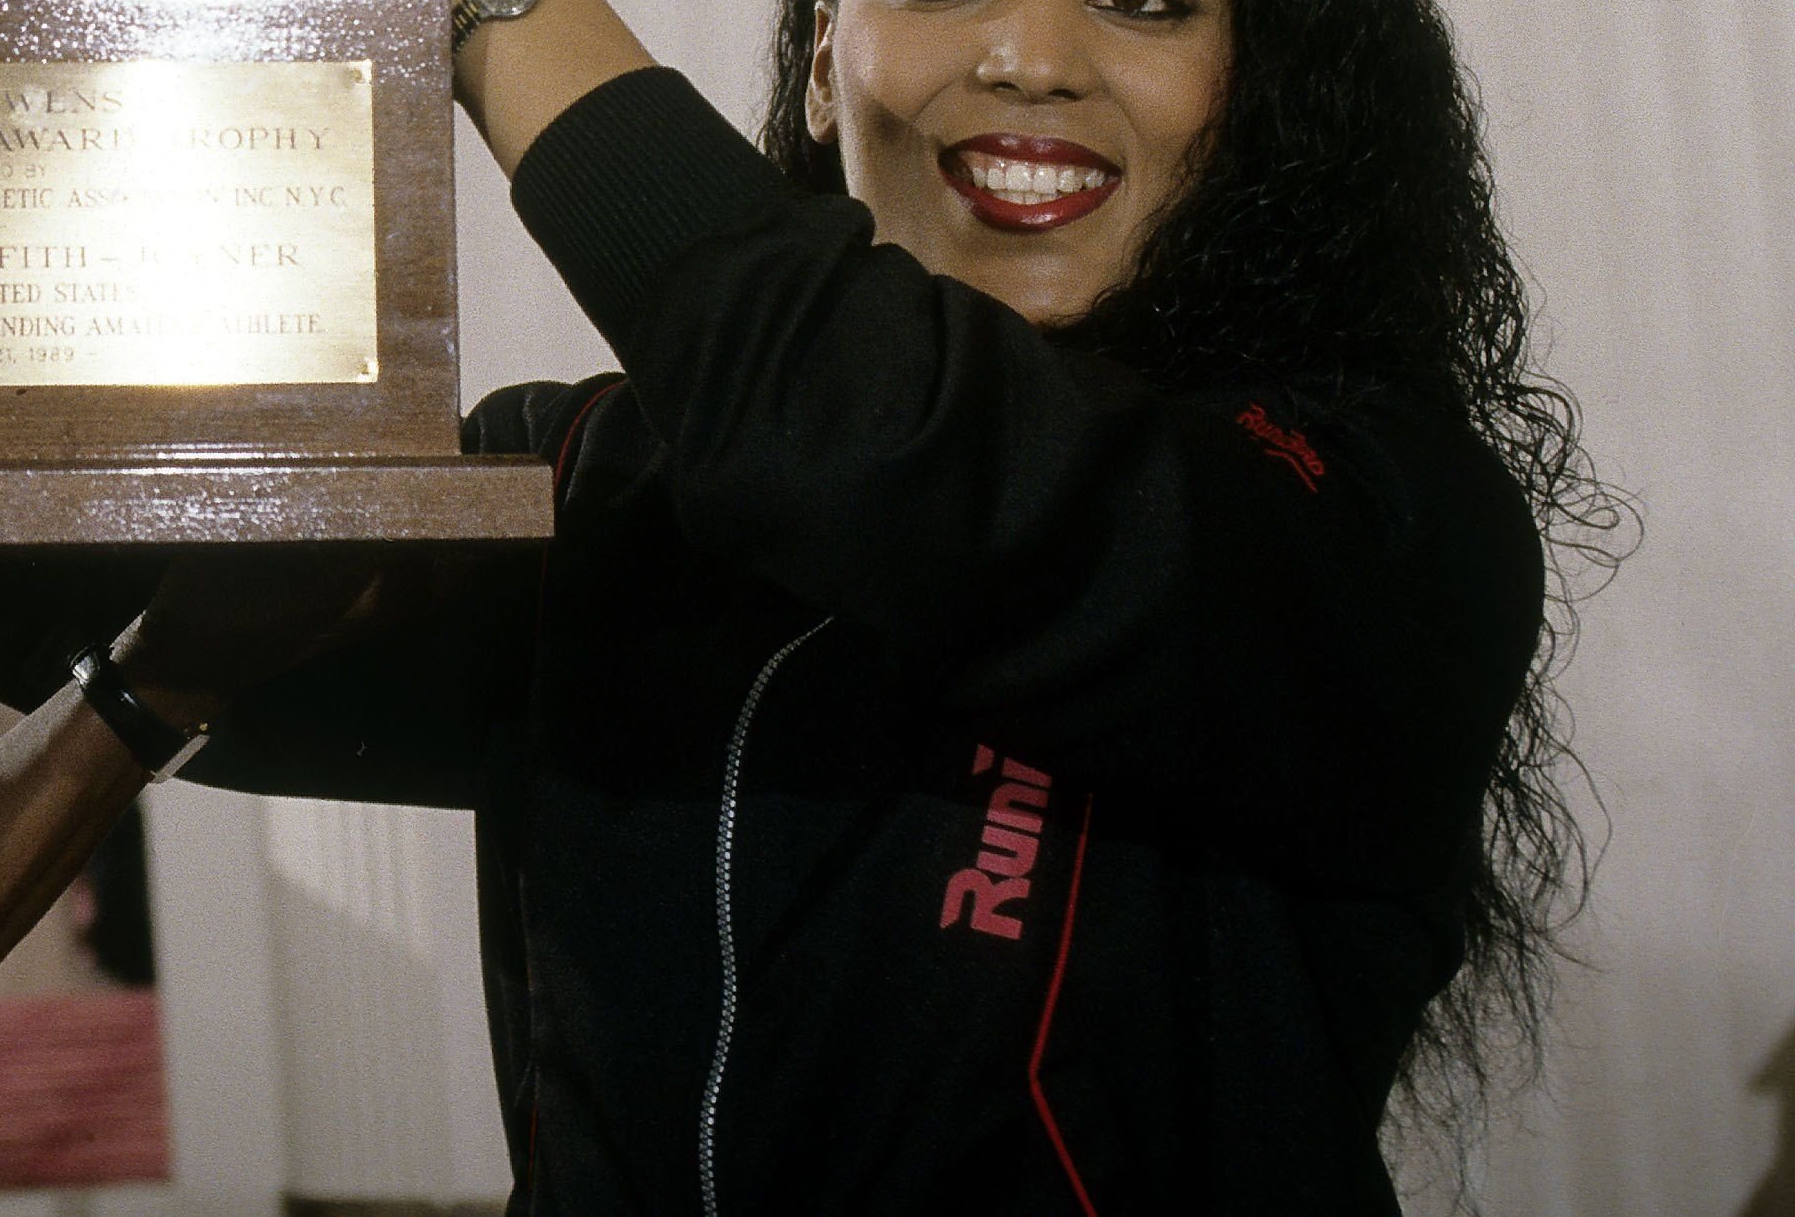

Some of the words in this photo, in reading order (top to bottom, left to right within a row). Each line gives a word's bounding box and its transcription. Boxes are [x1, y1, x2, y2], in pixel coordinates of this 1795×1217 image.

[170, 126, 331, 151] ROPHY
[130, 245, 304, 270] JNER
[25, 346, 76, 365] 1989
